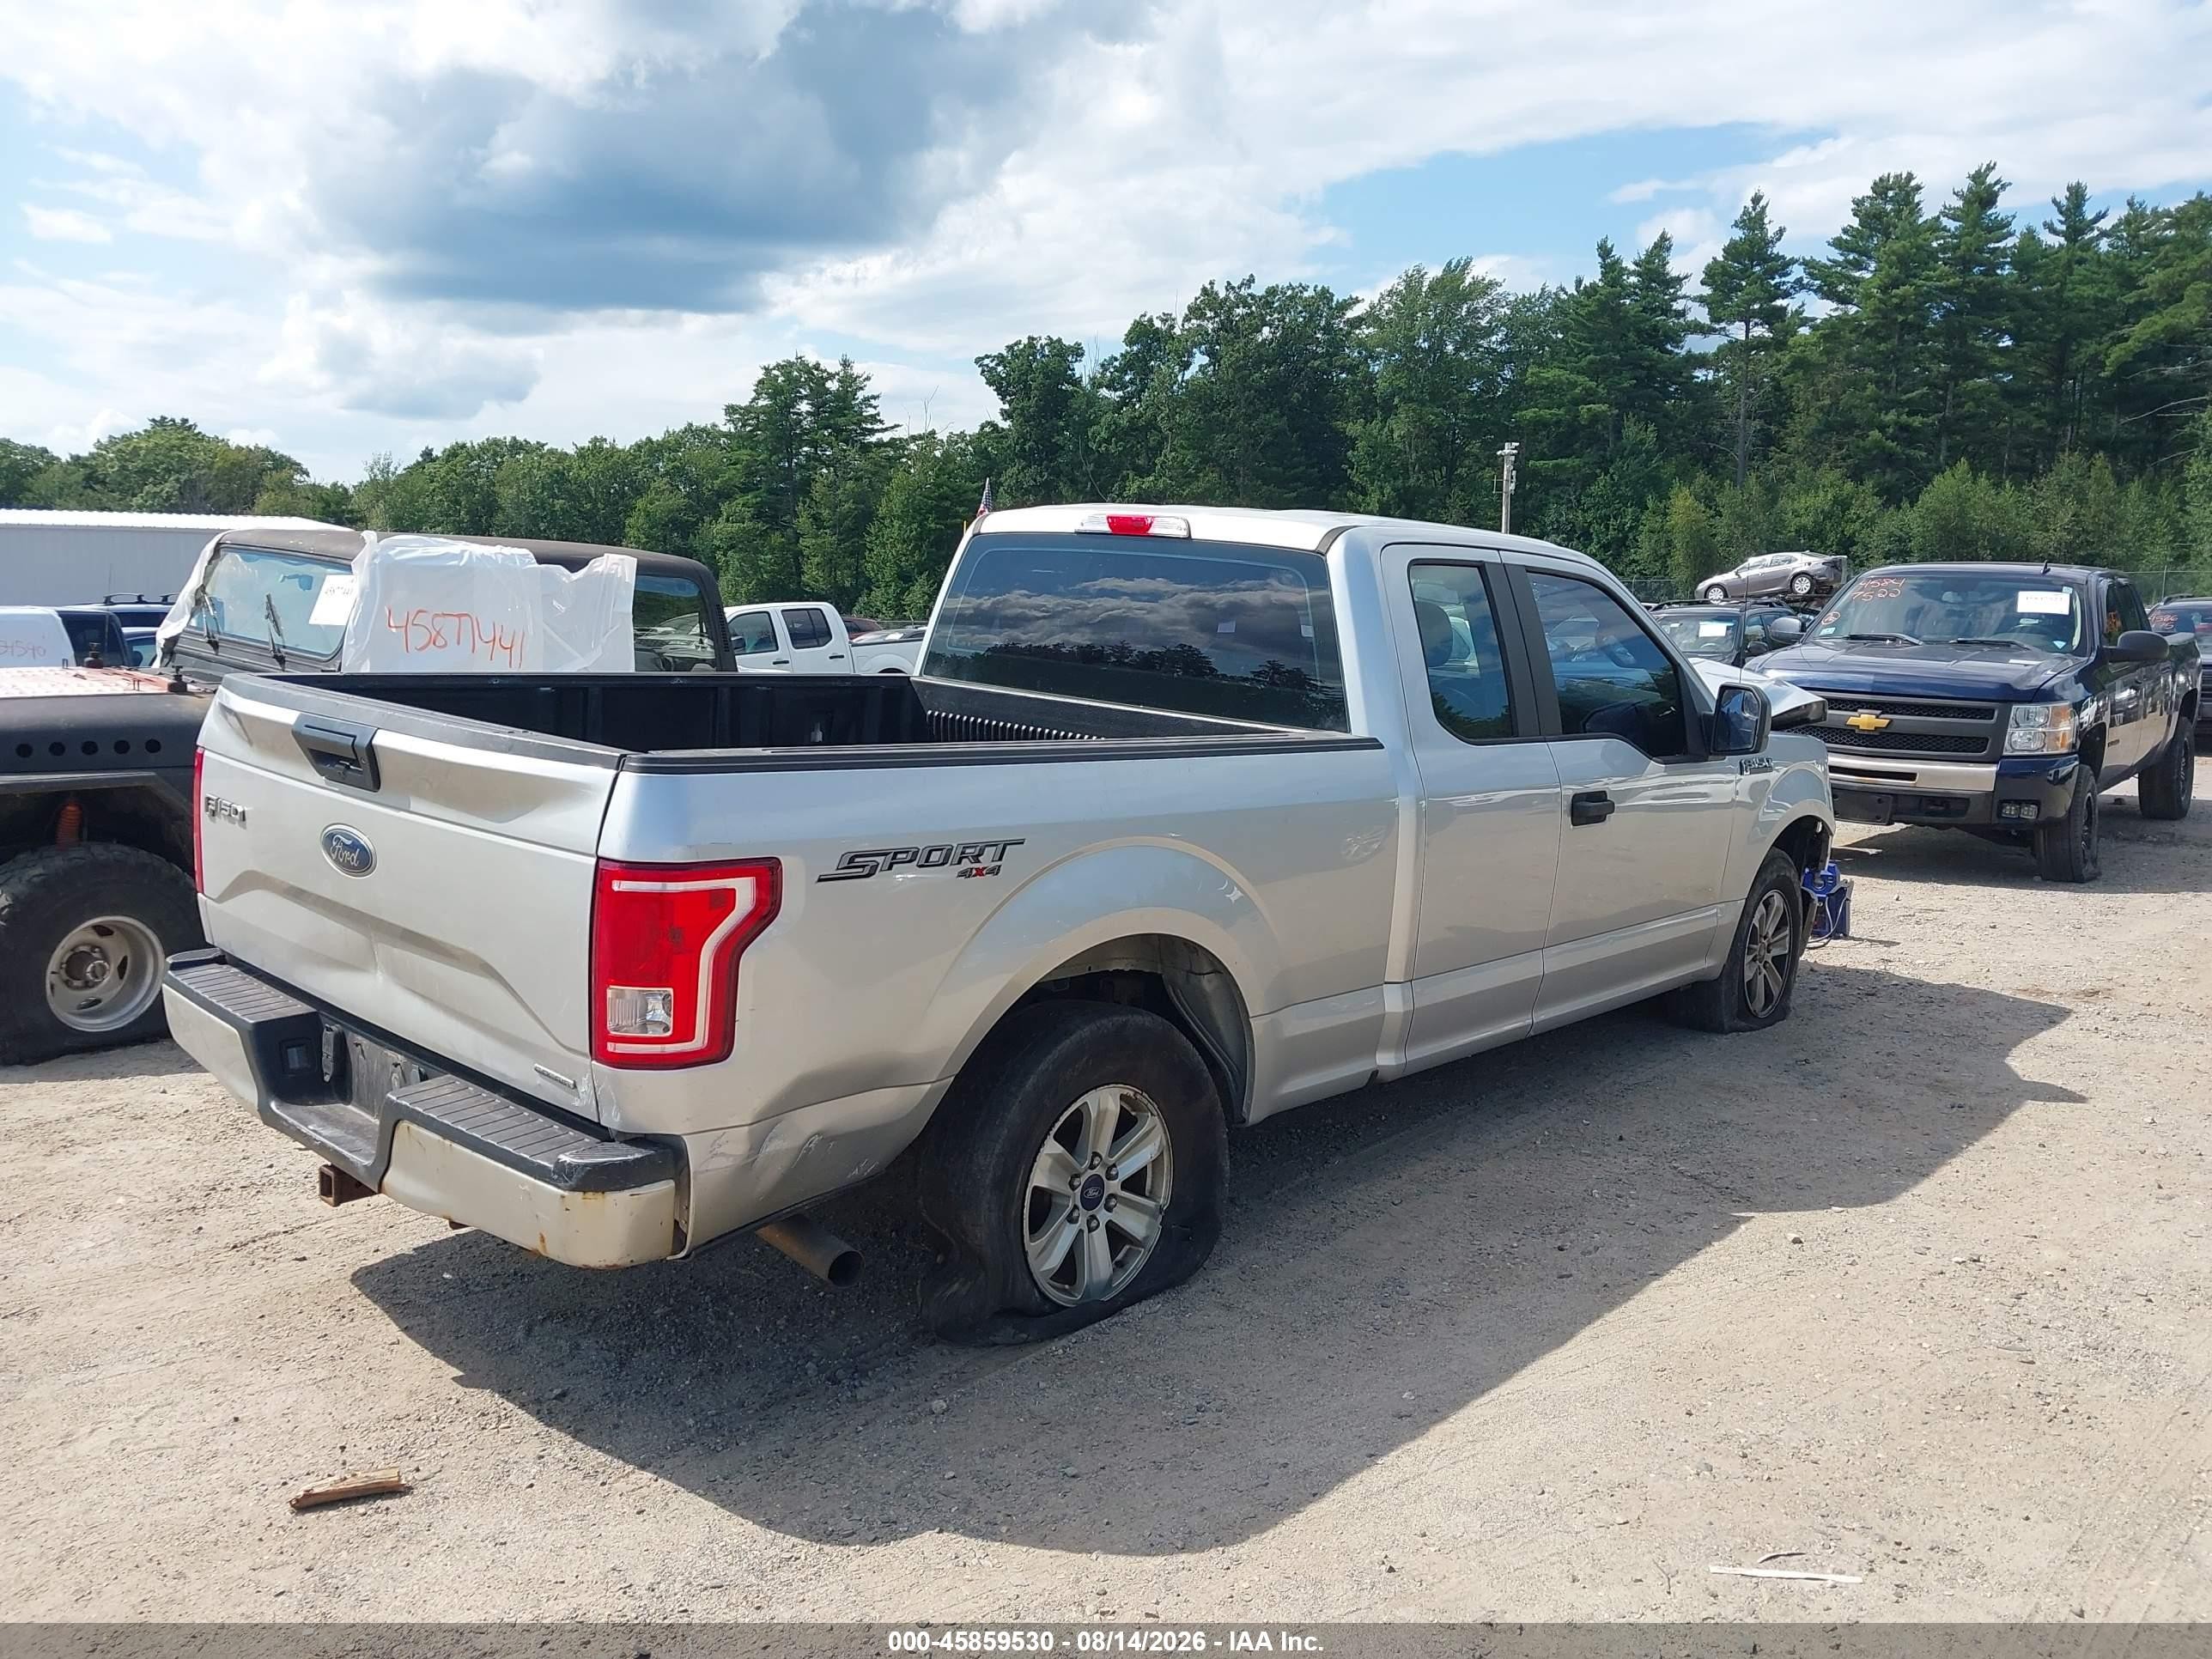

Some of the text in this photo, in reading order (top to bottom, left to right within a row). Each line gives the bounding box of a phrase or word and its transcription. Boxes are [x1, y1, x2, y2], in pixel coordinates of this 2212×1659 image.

[386, 605, 526, 669] 45877441
[330, 834, 361, 866] Ford
[816, 838, 1026, 883] SPORT
